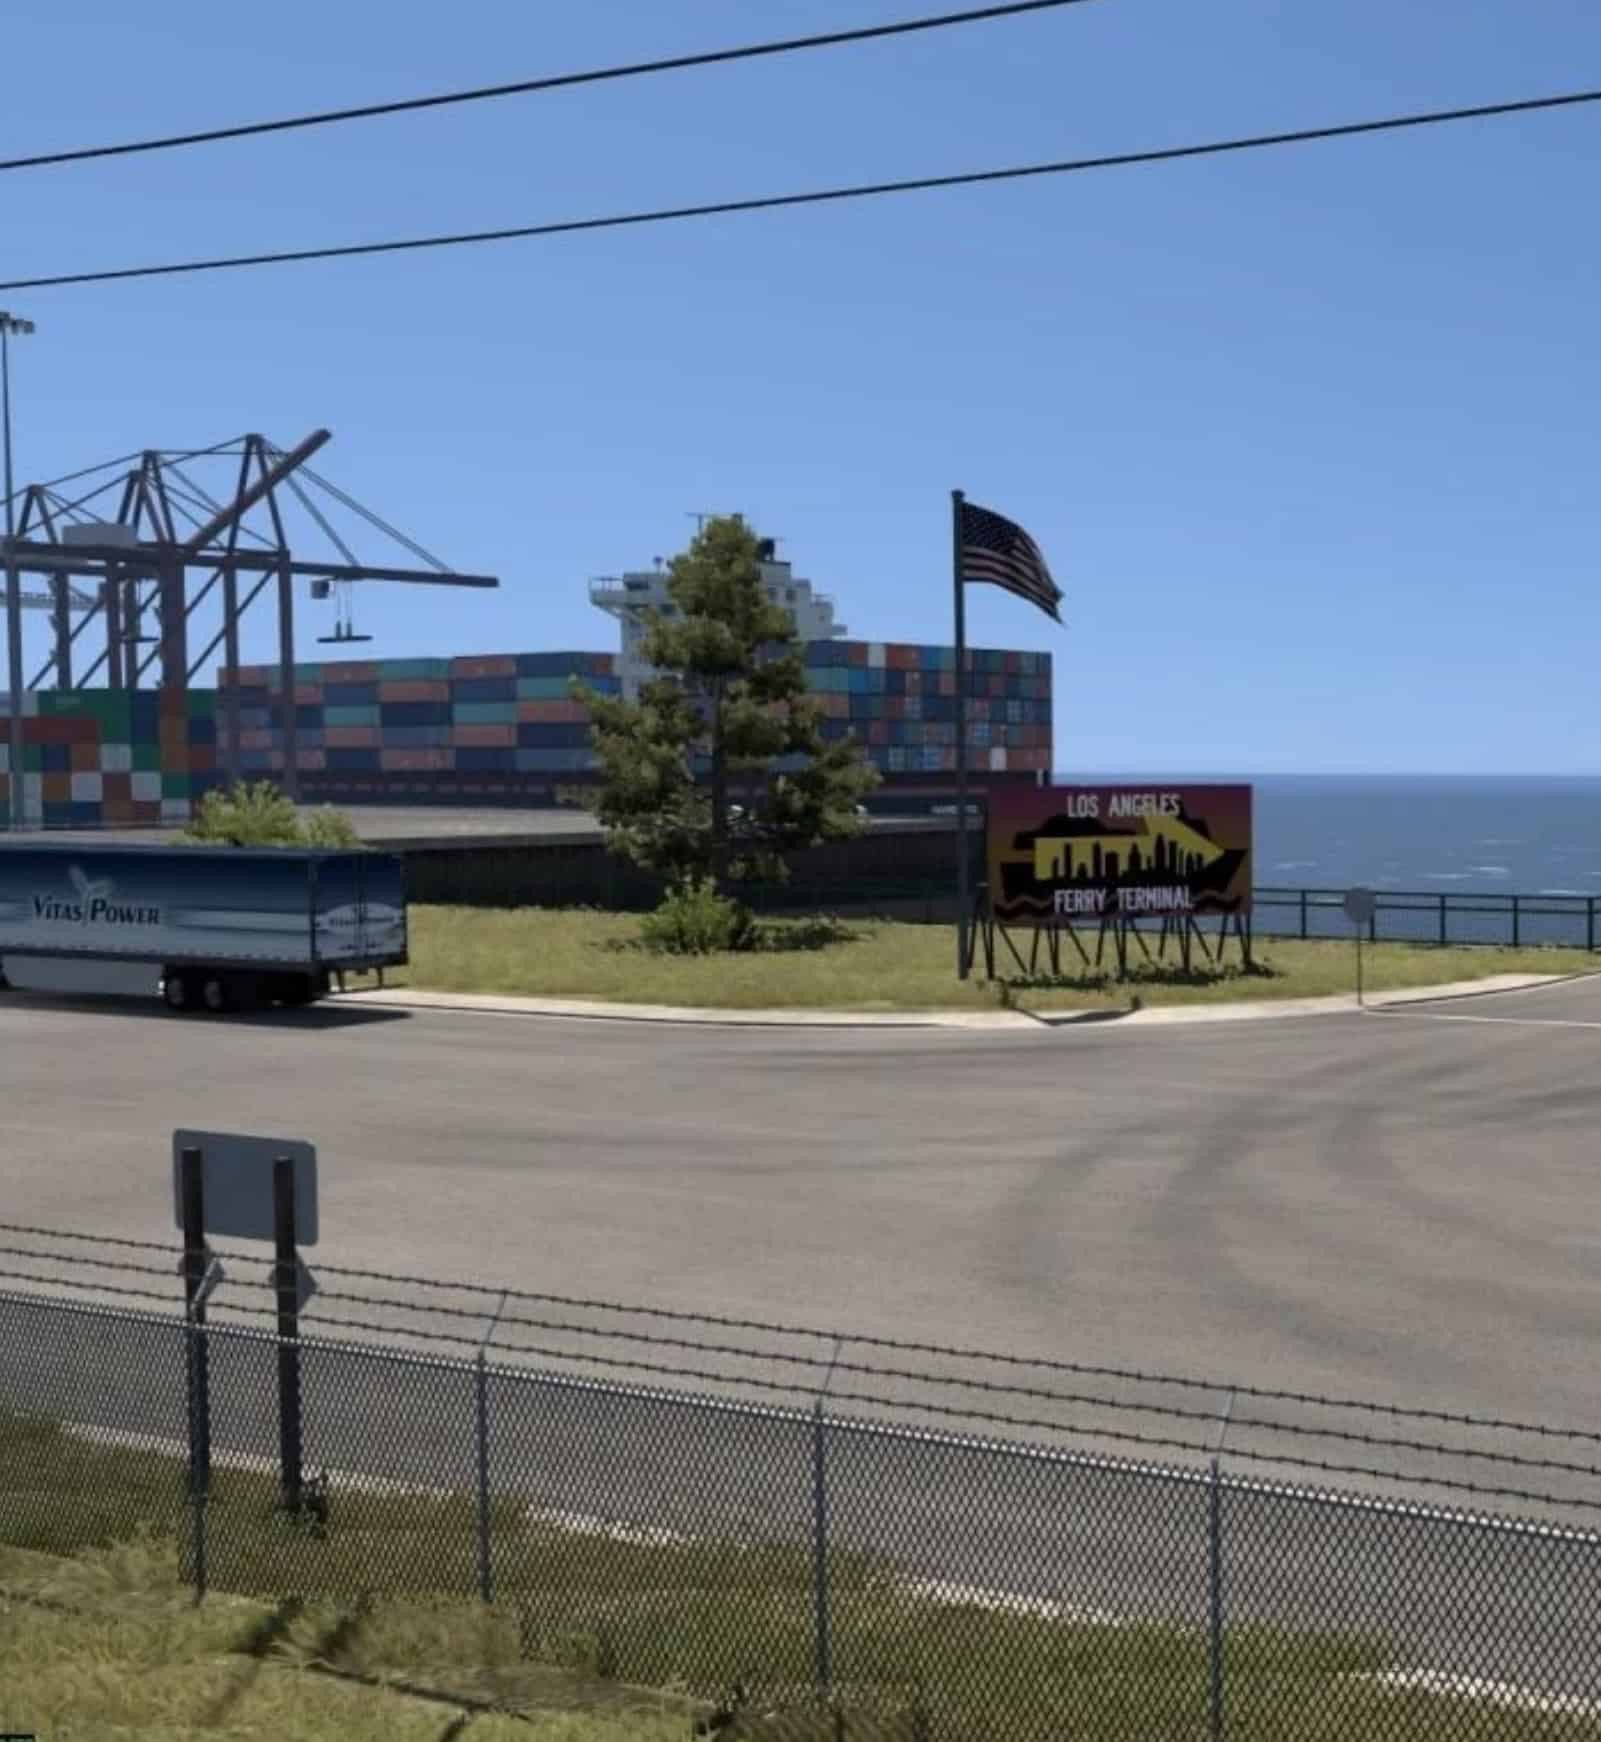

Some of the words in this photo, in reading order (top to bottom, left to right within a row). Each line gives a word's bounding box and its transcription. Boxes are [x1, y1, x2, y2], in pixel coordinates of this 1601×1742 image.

[1066, 794, 1099, 818] LOS
[1108, 793, 1181, 817] ANGELES
[1053, 888, 1106, 913] FERRY
[1116, 884, 1194, 911] TERMINAL
